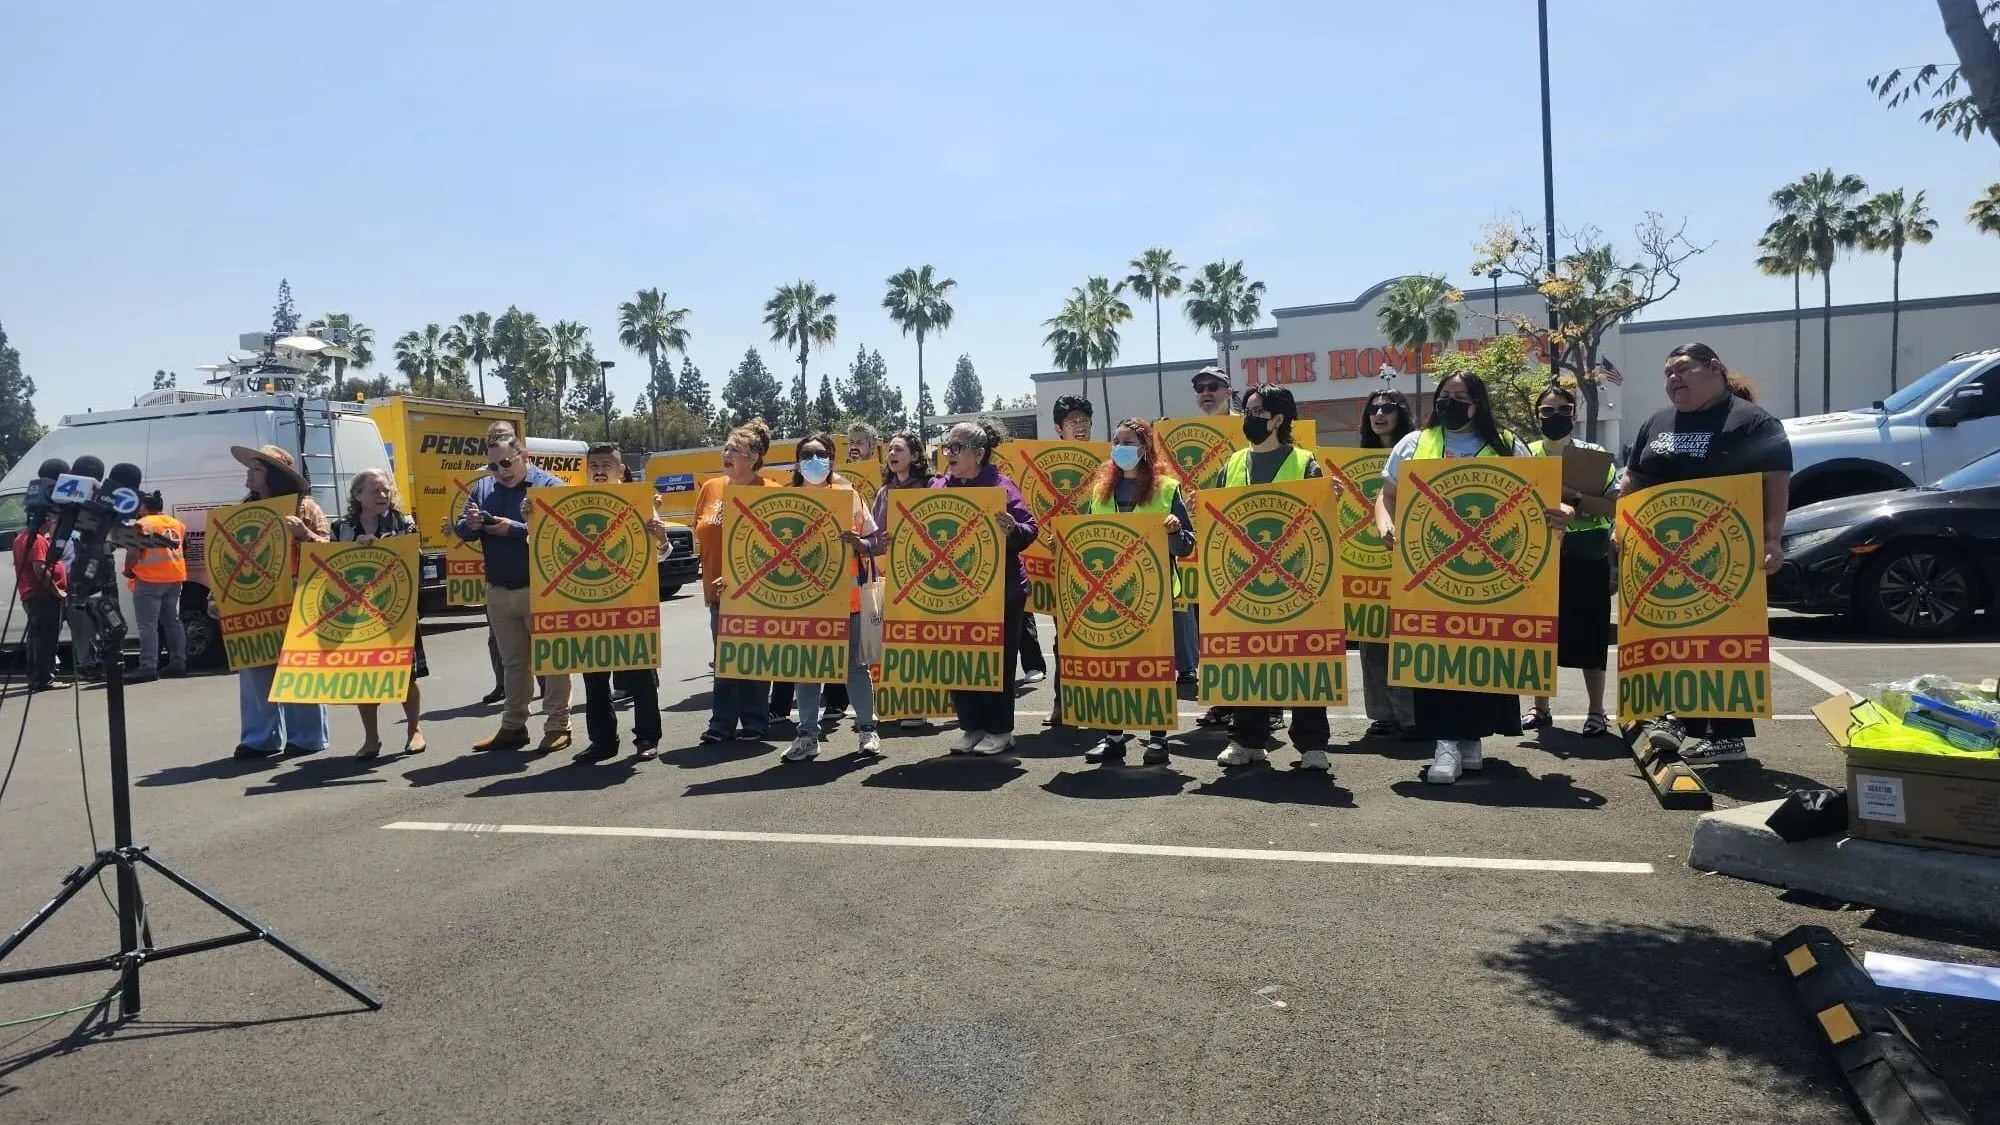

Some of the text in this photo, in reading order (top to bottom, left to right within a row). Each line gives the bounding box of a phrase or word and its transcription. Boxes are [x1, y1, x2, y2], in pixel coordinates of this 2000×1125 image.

[1241, 352, 1317, 387] THE
[1688, 434, 1711, 442] LIKE
[441, 459, 463, 471] Truck
[56, 479, 78, 497] 4
[1432, 471, 1532, 505] DEPARTMET
[1527, 506, 1543, 525] OF
[1638, 495, 1731, 524] DEPARTMET
[1727, 526, 1745, 544] OF
[981, 530, 992, 546] OF
[1309, 525, 1324, 544] OF
[449, 562, 475, 574] ICE
[1142, 558, 1155, 575] OF
[221, 607, 291, 633] ICE OUT O
[534, 609, 656, 631] ICE OUT OF
[721, 618, 847, 638] ICE OUT OF
[885, 623, 1000, 643] ICE OUT OF
[1393, 613, 1553, 639] ICE OUT OF
[534, 631, 656, 672] POMONA!
[1203, 633, 1341, 654] ICE OUT OF
[1619, 639, 1763, 668] ICE OUT OF
[282, 649, 410, 666] ICE OUT OF
[719, 641, 845, 680] POMONA!
[882, 648, 1001, 687] POMONA!
[1061, 658, 1171, 679] ICE OUT OF
[1391, 641, 1553, 692] POMONA!
[273, 670, 407, 700] POMONA!
[1202, 661, 1343, 702] POMONA!
[1619, 669, 1766, 718] POMONA!
[1062, 684, 1174, 726] POMONA!
